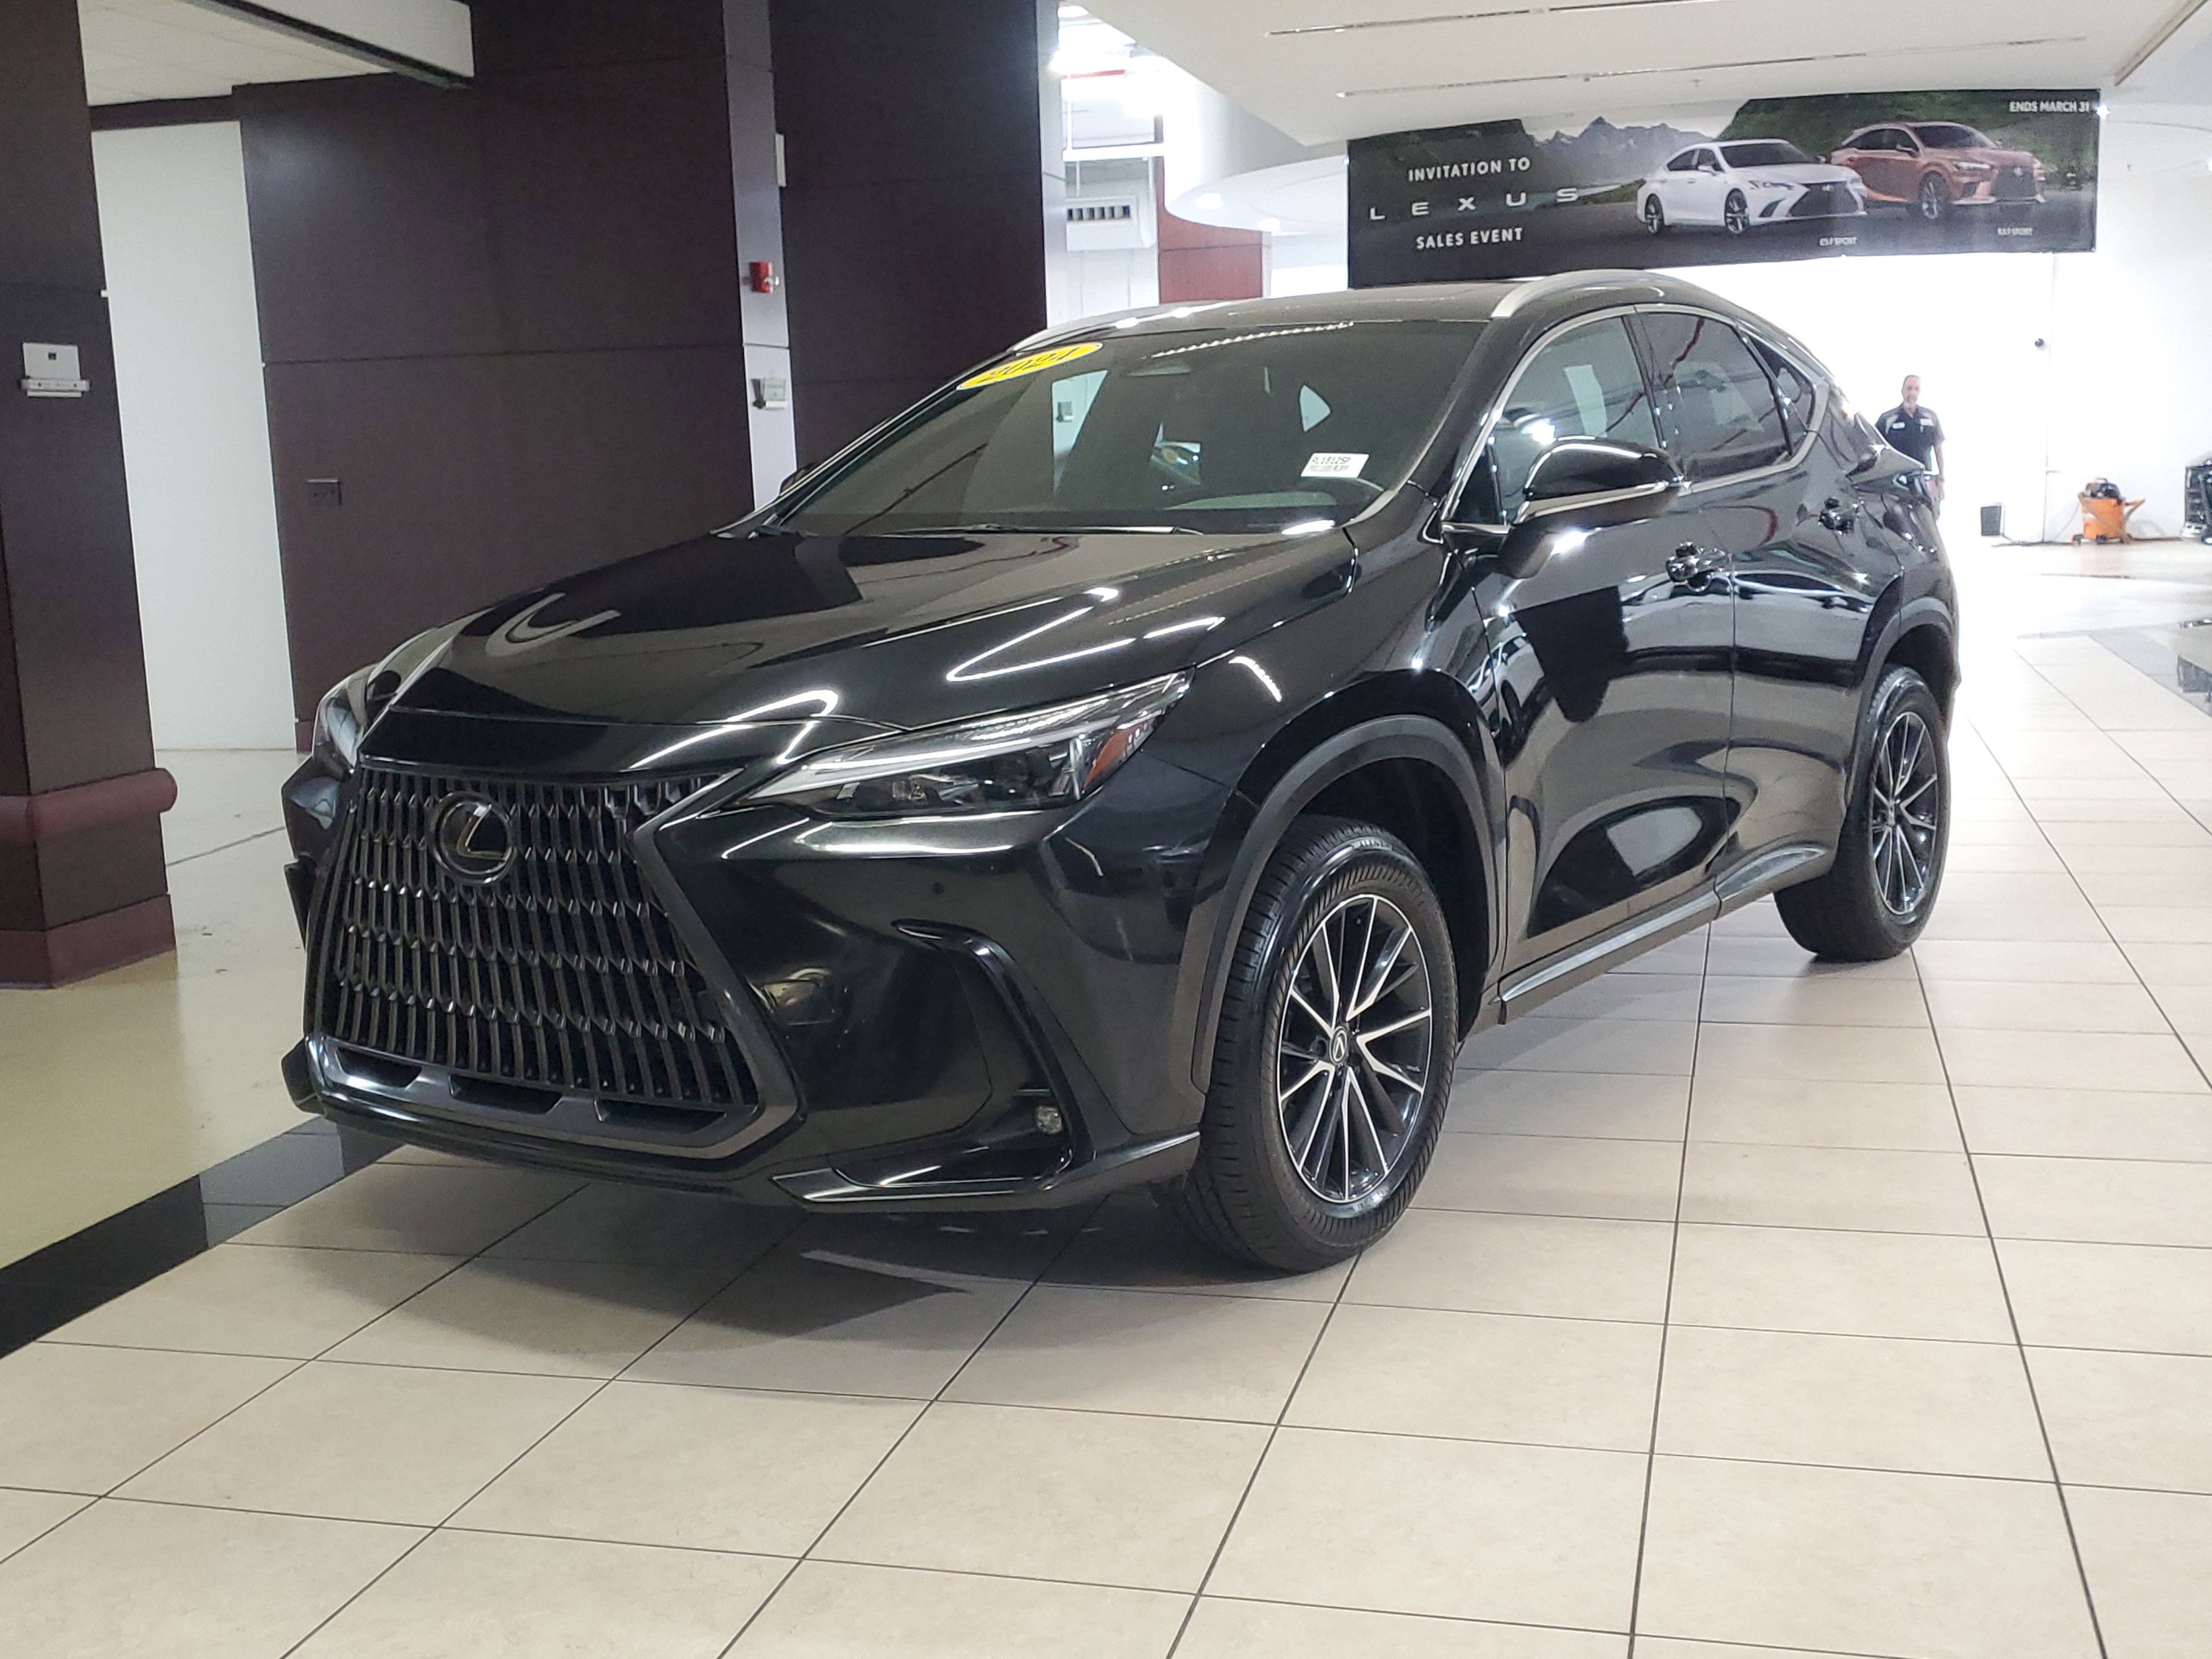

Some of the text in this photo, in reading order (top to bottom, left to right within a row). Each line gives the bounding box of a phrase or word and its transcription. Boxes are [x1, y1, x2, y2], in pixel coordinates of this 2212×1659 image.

[2009, 101, 2090, 113] ENDS MARCH 31
[1408, 157, 1530, 182] INVITATION TO
[1369, 187, 1579, 220] LEXUS
[1416, 227, 1523, 249] SALES EVENT
